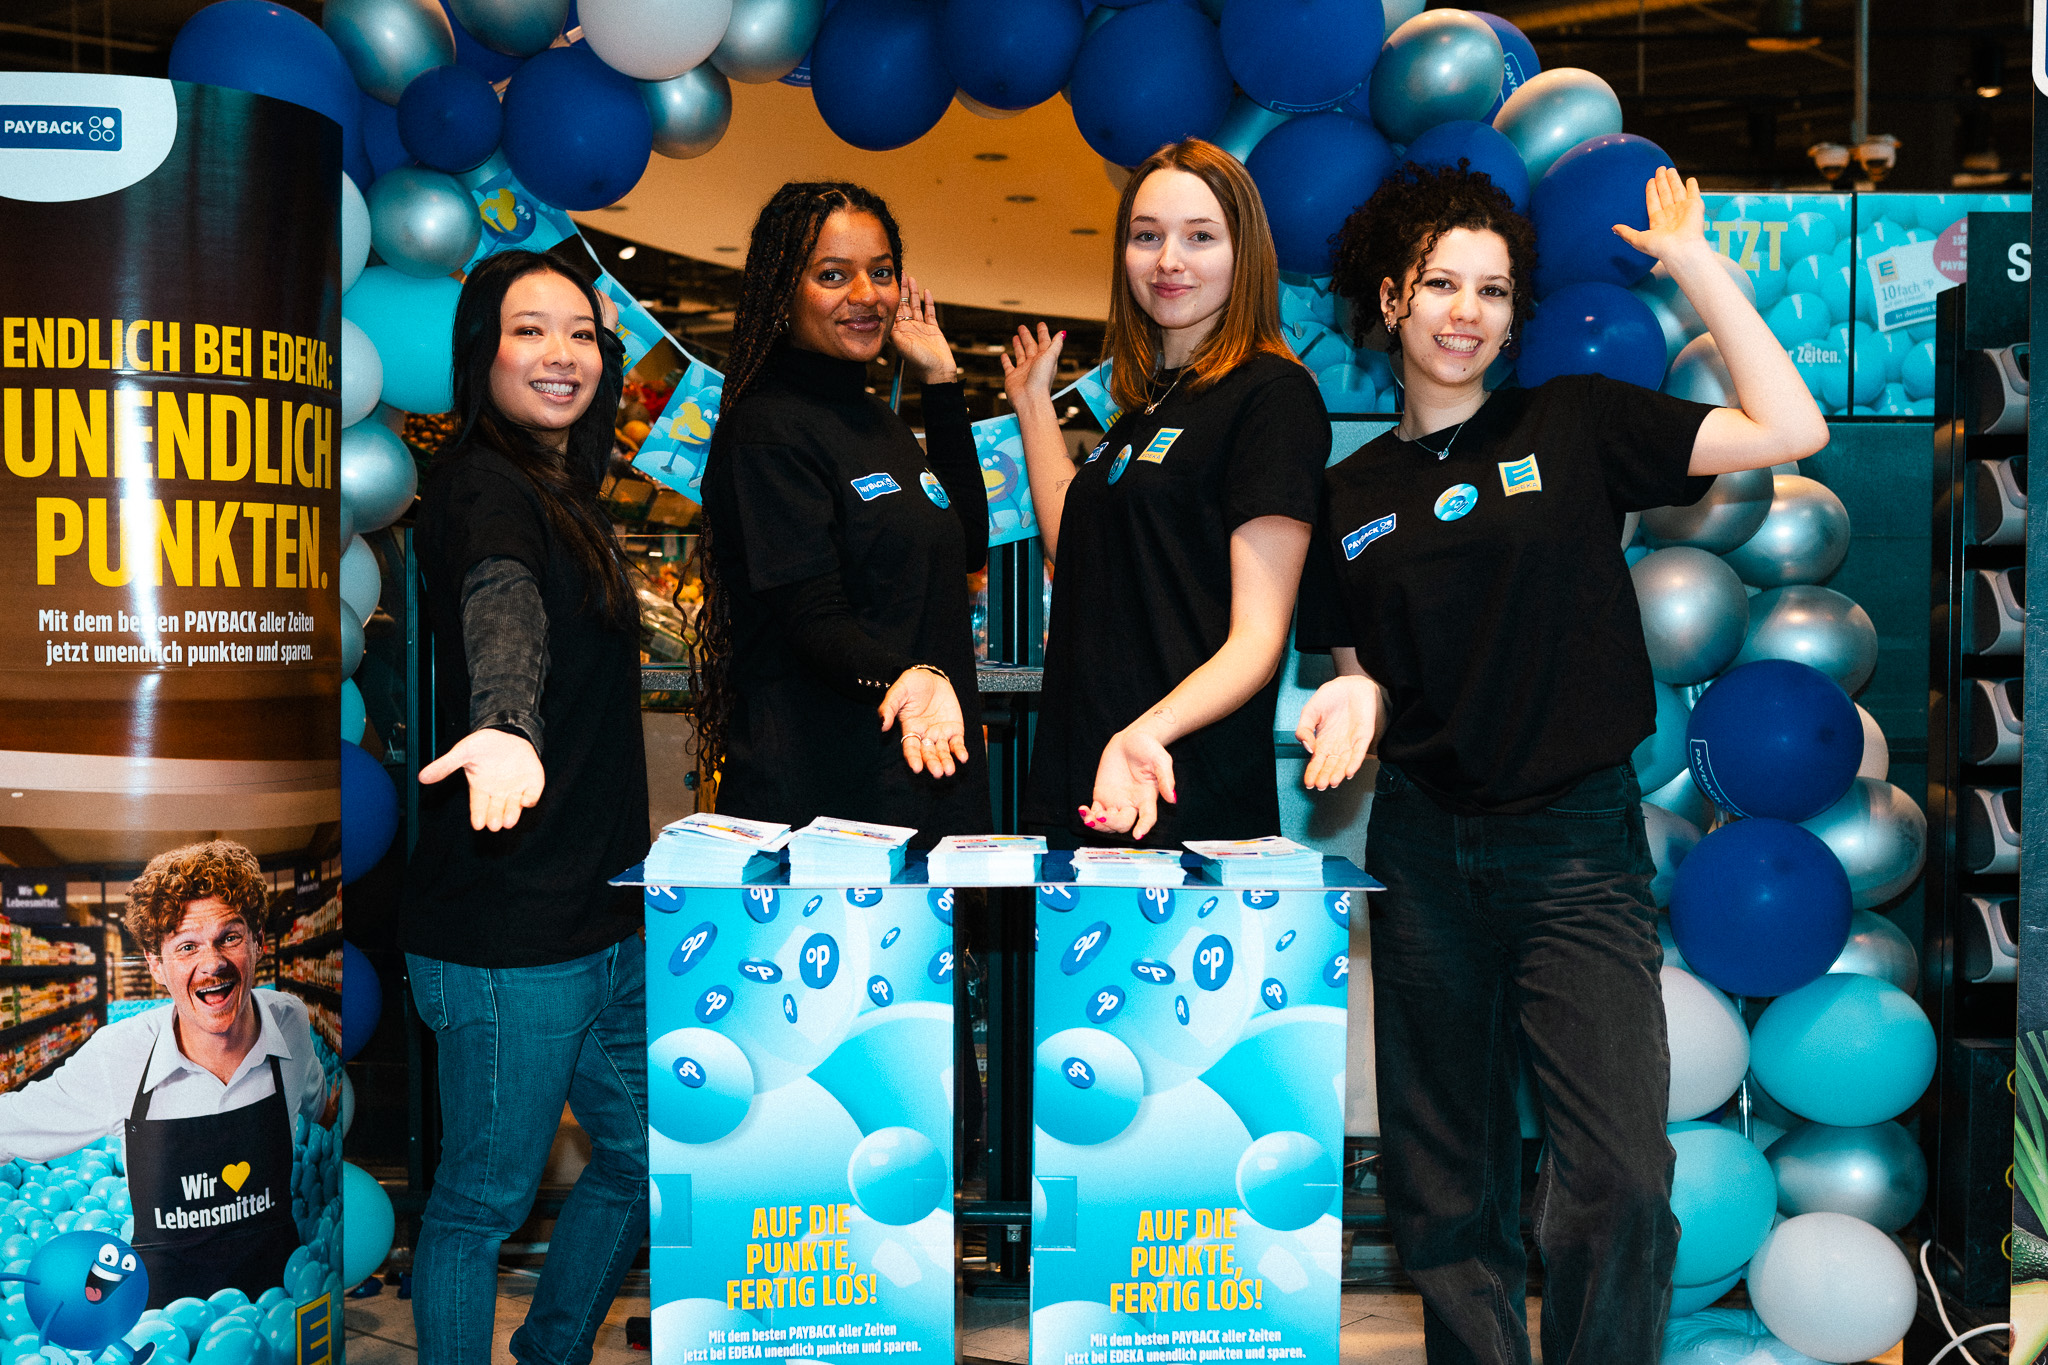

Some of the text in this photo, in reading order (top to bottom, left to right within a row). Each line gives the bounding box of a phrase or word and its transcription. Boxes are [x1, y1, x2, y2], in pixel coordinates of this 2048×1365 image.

[4, 120, 84, 135] PAYBACK
[1703, 221, 1788, 271] TZT
[3, 316, 333, 390] ENDLICH BEI EDEKA:
[1797, 345, 1841, 364] Zeiten.
[3, 387, 332, 490] UNENDLICH
[1508, 482, 1538, 493] EDEKA
[36, 496, 328, 590] PUNKTEN.
[1347, 525, 1379, 551] PAYBACK
[38, 609, 314, 633] Mit dem been PAYBACK aller Zeiten
[46, 640, 314, 666] jetzt unendlich punkten und sparen.
[181, 1172, 217, 1201] Wir
[154, 1187, 276, 1229] Lebensmittel.
[752, 1203, 850, 1239] AUF DIE
[1137, 1208, 1237, 1242] AUF DIE
[746, 1239, 857, 1275] PUNKTE,
[1130, 1244, 1243, 1281] PUNKTE,
[726, 1274, 877, 1311] FERTIG LOS!
[1110, 1279, 1263, 1314] FERTIG LOS!
[708, 1323, 896, 1344] Mit dem besten PAYBACK aller Zeiten
[1090, 1328, 1282, 1347] Mit dem besten PAYBACK aller Zeiten
[683, 1339, 922, 1363] jetzt bei EDEKA unendlich punkten und sparen.
[1064, 1345, 1307, 1365] jetzt bei EDEKA unendlich punkten und sparen.
